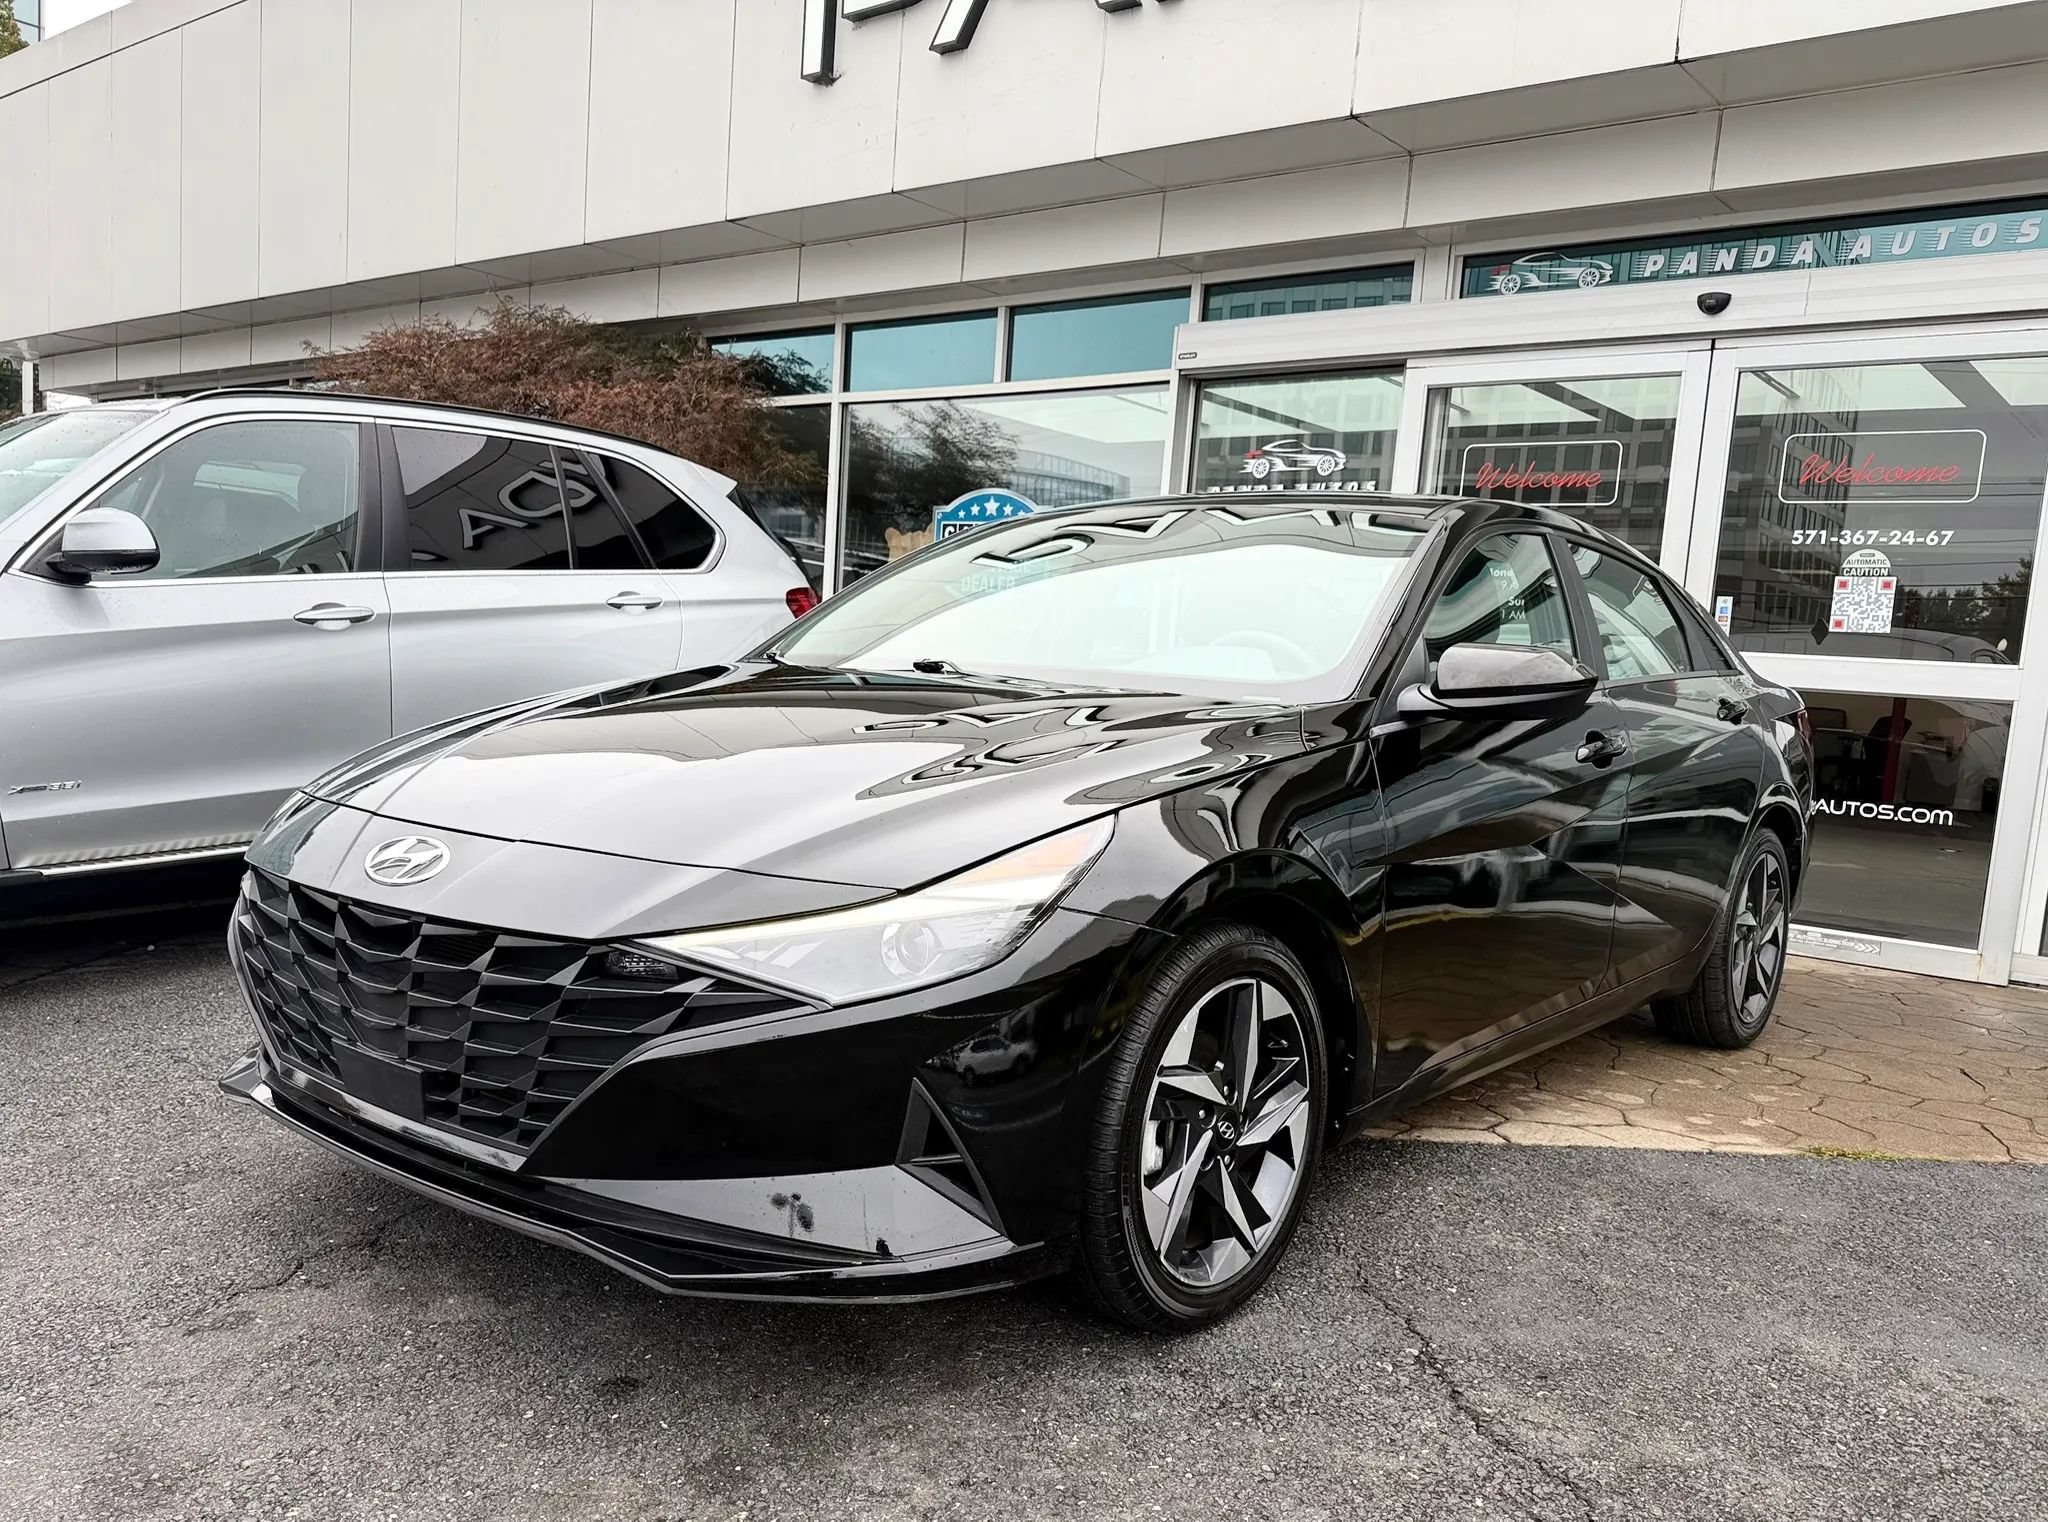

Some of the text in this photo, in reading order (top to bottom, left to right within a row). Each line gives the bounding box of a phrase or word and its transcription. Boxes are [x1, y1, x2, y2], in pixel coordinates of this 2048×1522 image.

[1632, 216, 2044, 278] PANDA AUTOS
[1475, 460, 1602, 490] Welcome
[1799, 451, 1961, 485] Welcome
[1791, 529, 1955, 546] 571-367-24-67
[1845, 558, 1888, 567] AUTOMATIC
[1843, 567, 1889, 577] CAUTION
[960, 574, 1016, 592] DEALER
